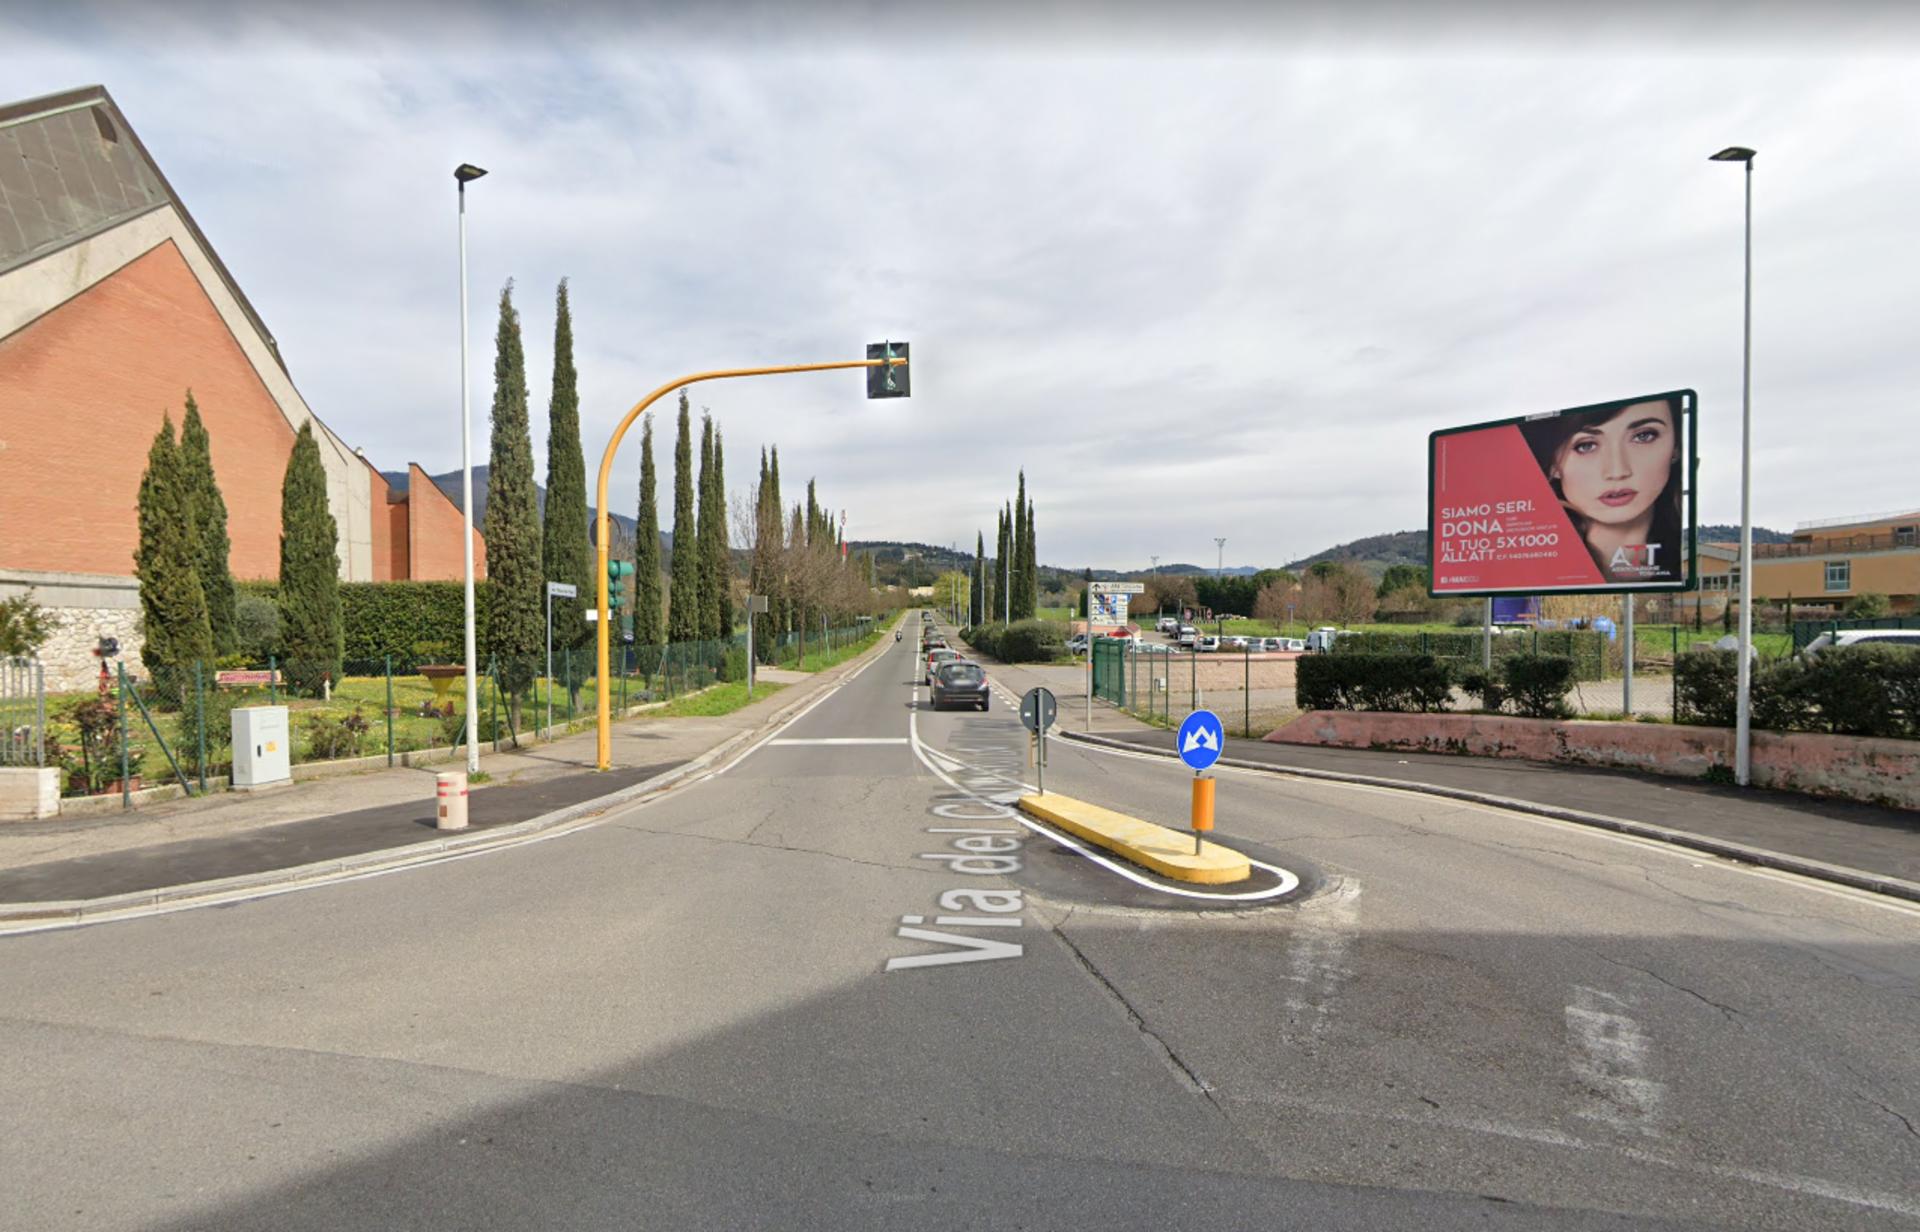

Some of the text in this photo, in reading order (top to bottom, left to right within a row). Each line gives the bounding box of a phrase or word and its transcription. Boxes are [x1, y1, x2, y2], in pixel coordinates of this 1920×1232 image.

[1441, 500, 1536, 519] SIAMO SERI.
[1441, 519, 1503, 538] DONA
[1441, 533, 1559, 553] IL TUO 5X1000
[1440, 549, 1496, 563] ALL'ATT
